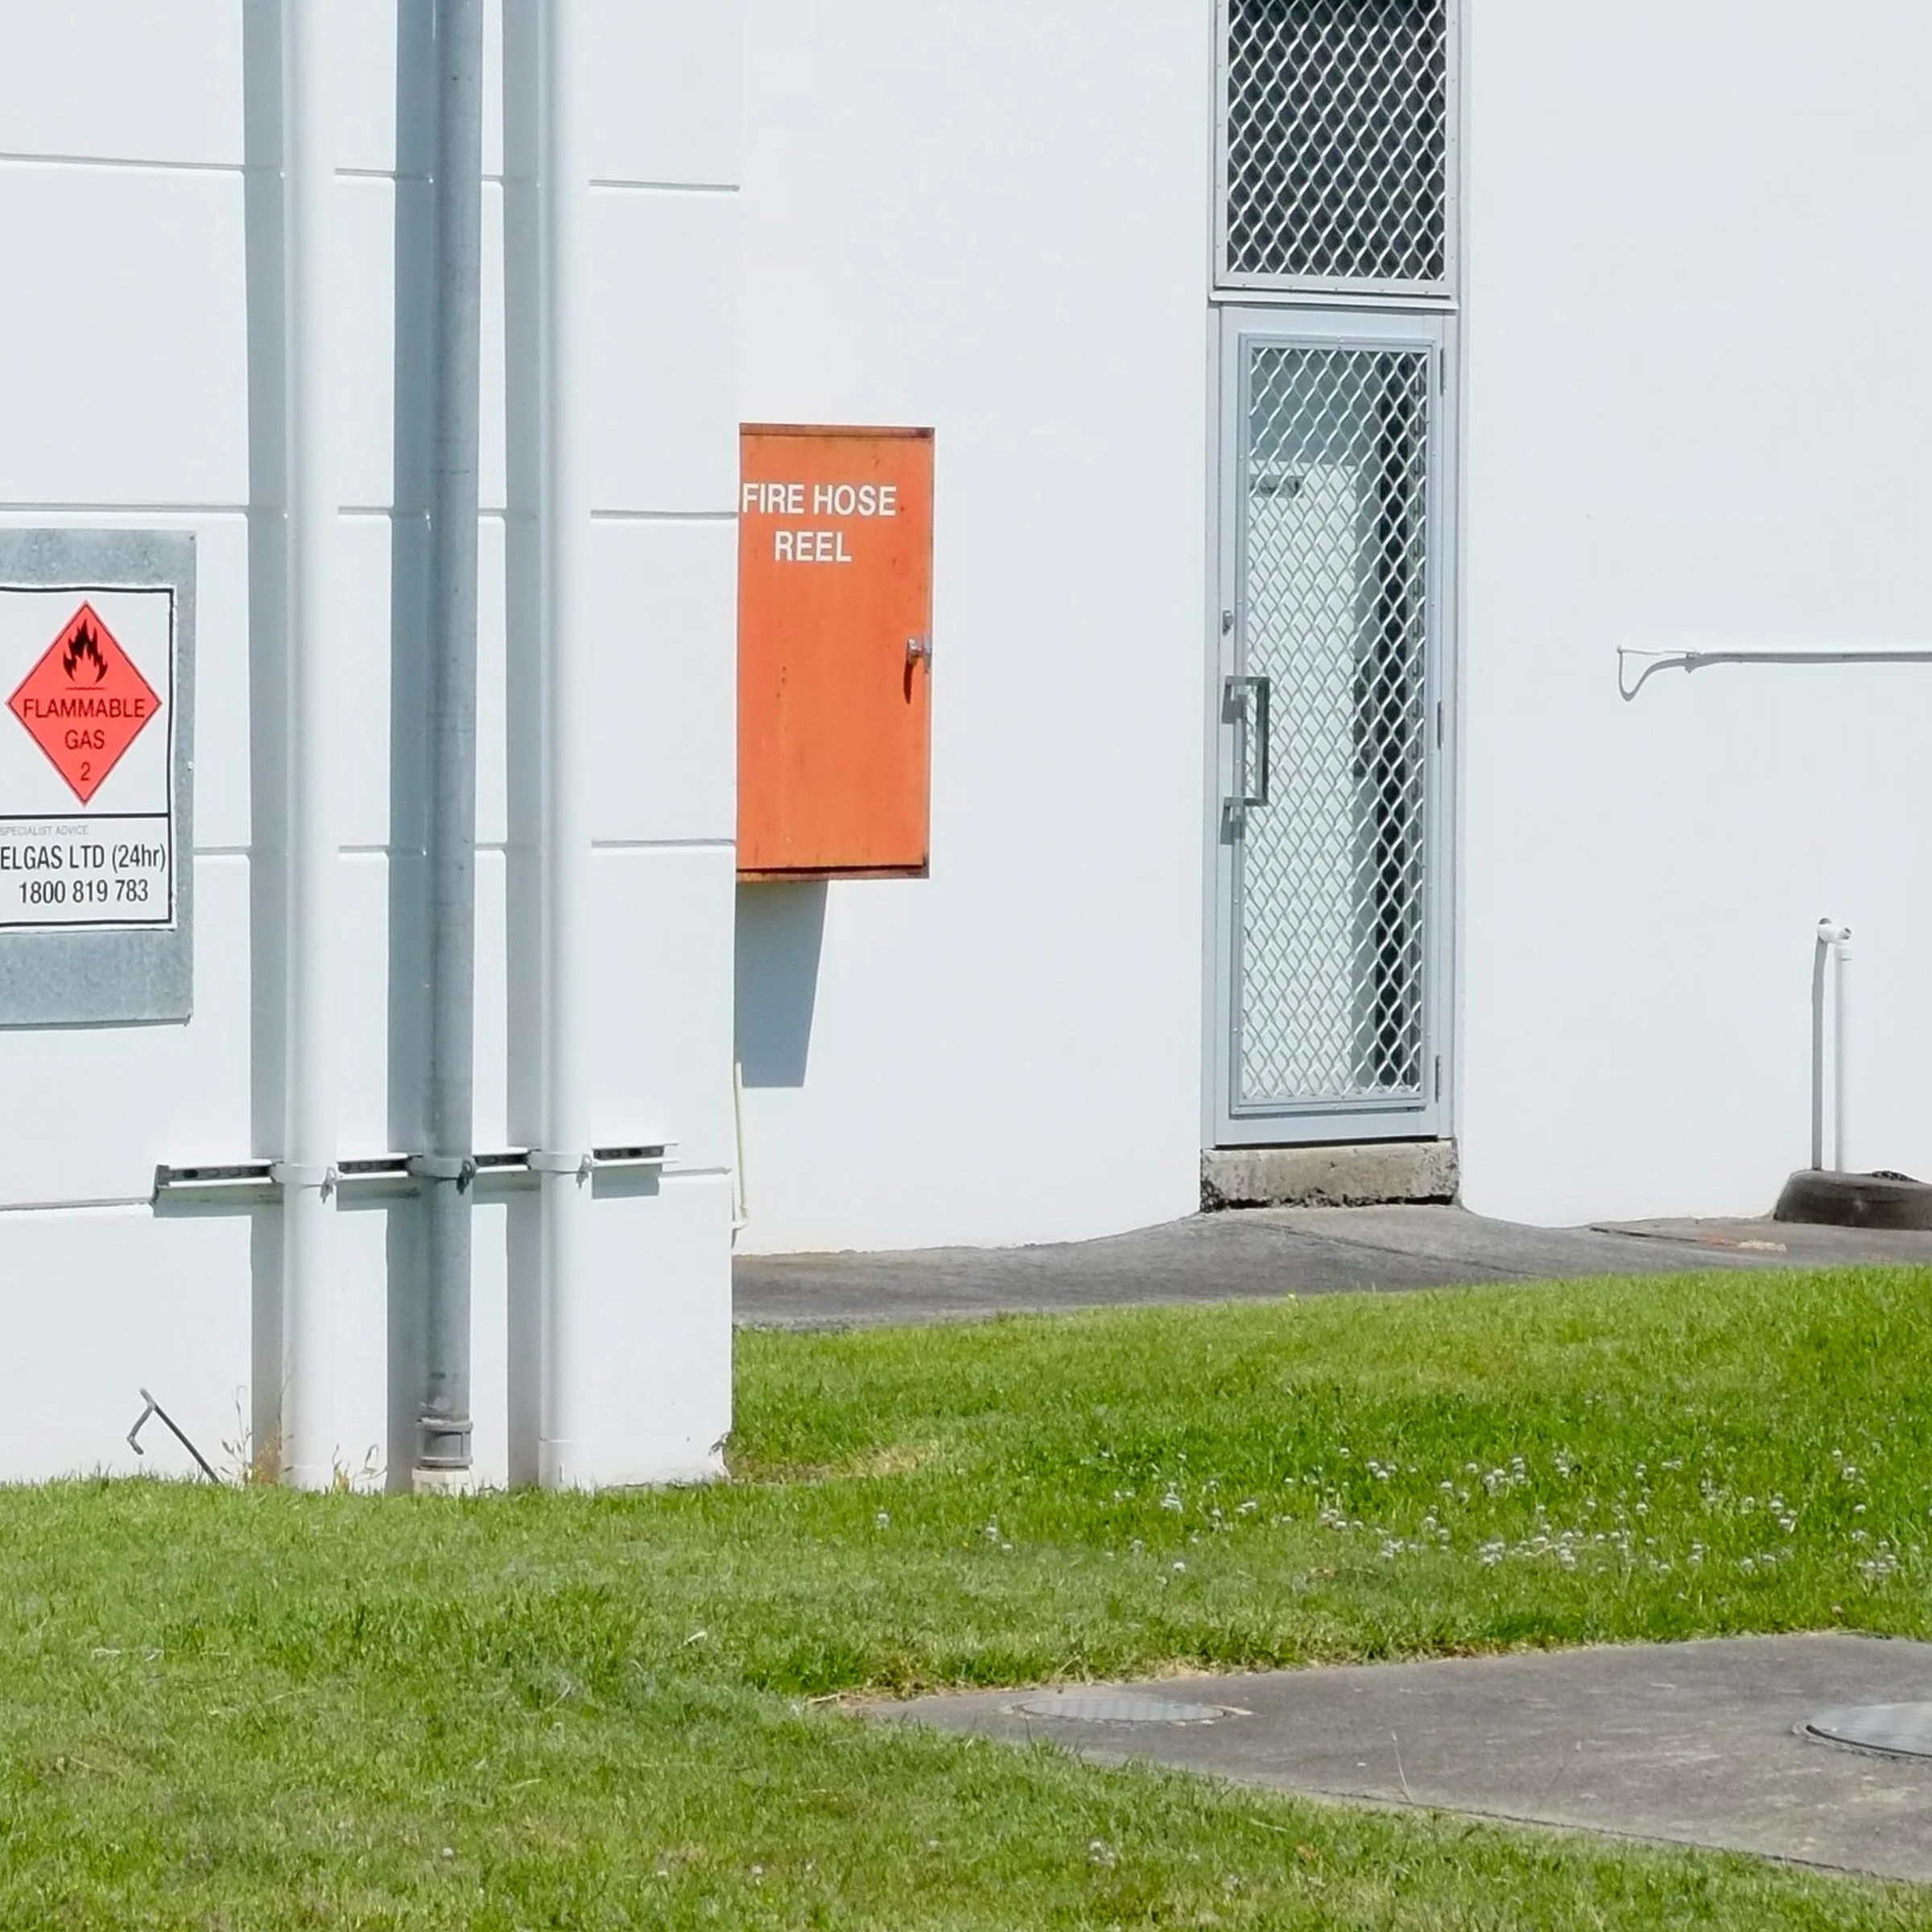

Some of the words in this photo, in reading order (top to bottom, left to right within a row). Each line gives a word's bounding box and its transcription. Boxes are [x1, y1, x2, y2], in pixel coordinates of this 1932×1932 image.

[741, 484, 804, 514] FIRE
[813, 485, 897, 516] HOSE
[774, 532, 852, 562] REEL
[23, 698, 145, 718] FLAMMABLE
[64, 729, 105, 749] GAS
[80, 762, 91, 781] 2
[0, 826, 52, 836] SPECIALIST
[56, 825, 89, 835] ADVICE
[1, 845, 63, 870] ELGAS
[69, 845, 105, 869] LTD
[112, 844, 166, 873] (24hr)
[19, 880, 65, 904] 1800
[72, 879, 108, 902] 819
[115, 879, 148, 902] 783
